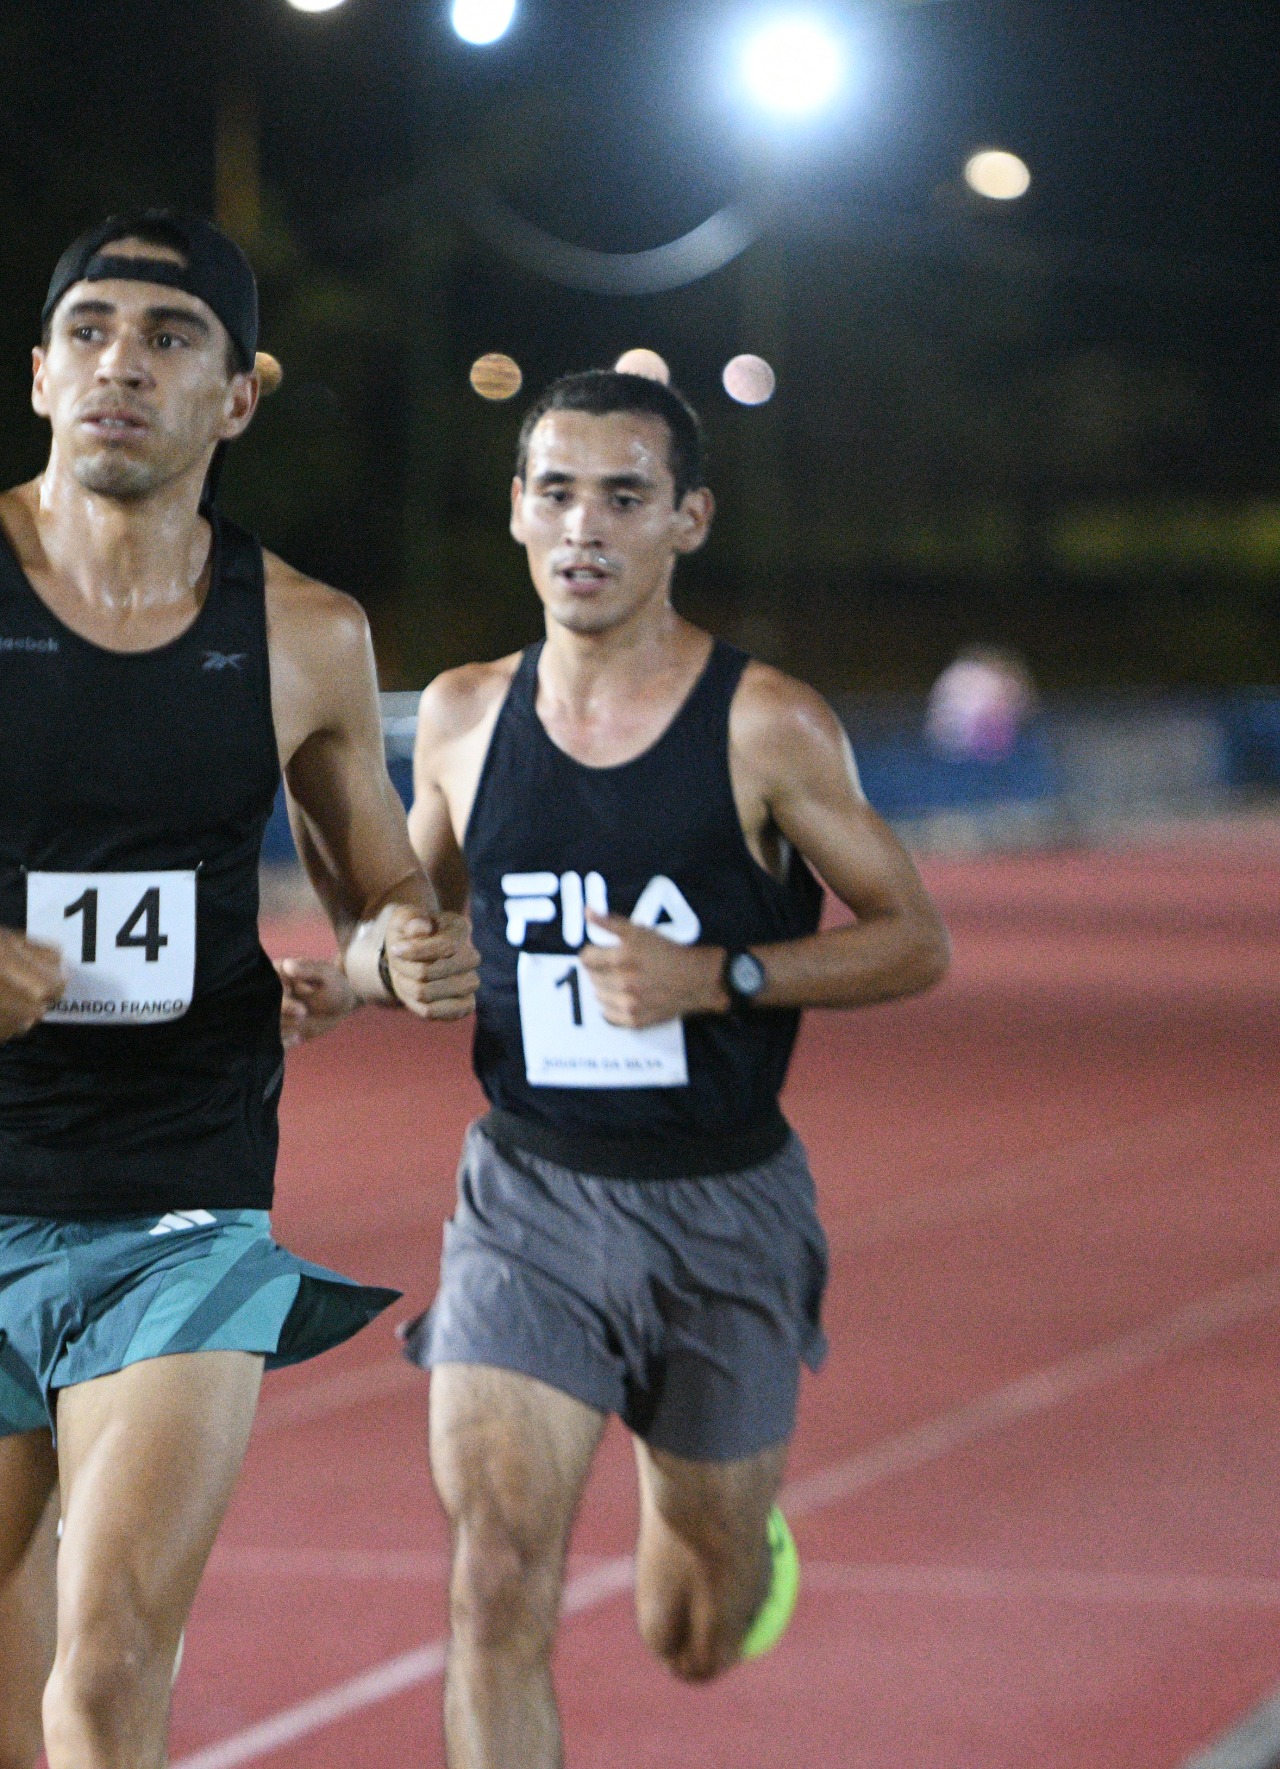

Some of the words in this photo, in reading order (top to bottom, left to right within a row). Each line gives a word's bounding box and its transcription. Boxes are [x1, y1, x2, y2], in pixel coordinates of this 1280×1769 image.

[63, 886, 169, 963] 14
[501, 870, 702, 948] FILA
[121, 998, 184, 1014] FRANCO
